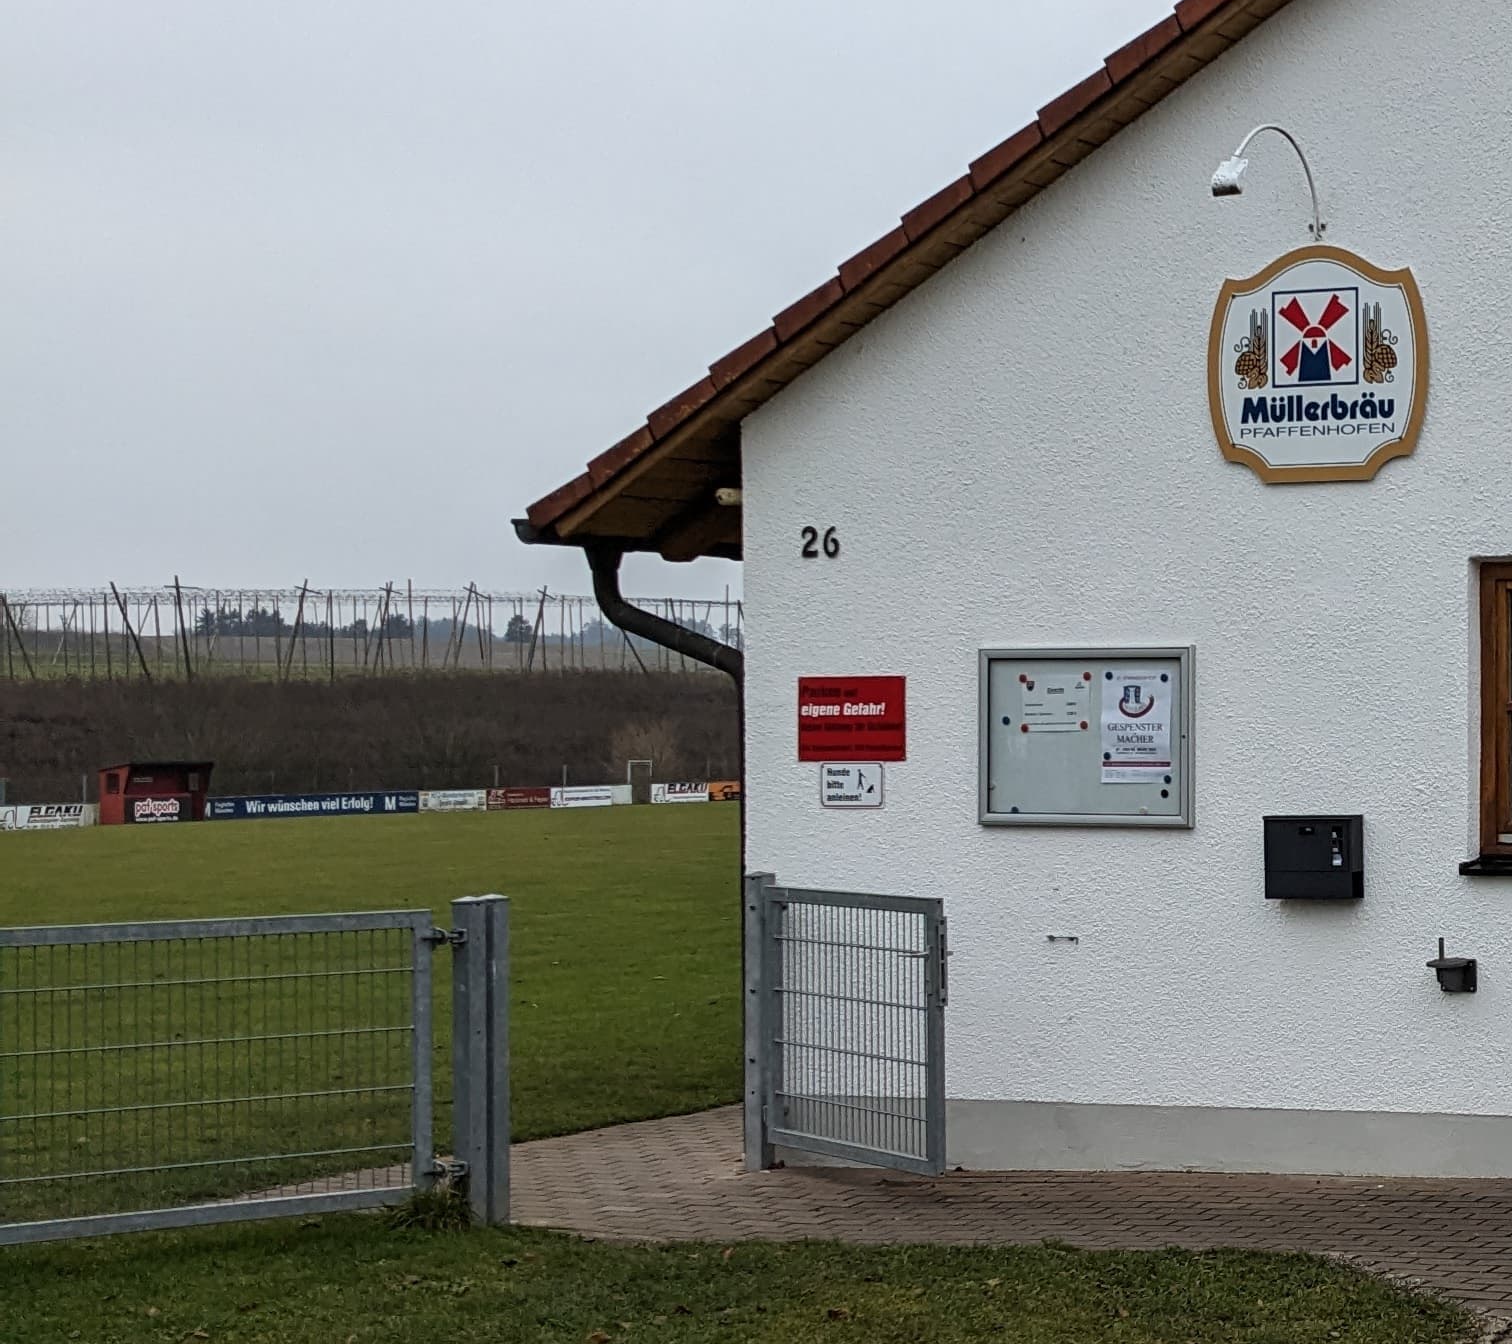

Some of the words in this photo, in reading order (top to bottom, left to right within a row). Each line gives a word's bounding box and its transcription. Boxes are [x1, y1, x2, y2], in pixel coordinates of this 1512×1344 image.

[1240, 392, 1395, 425] Müllerbräu
[1240, 422, 1396, 439] PFAFFENHOFEN
[801, 525, 840, 559] 26
[800, 704, 841, 717] eigene
[843, 702, 886, 716] Gefahr!
[1107, 722, 1163, 733] GESPENSTER
[1116, 735, 1155, 745] MACHER
[245, 800, 266, 814] Wir
[267, 799, 320, 813] wünschen
[321, 797, 341, 811] viel
[342, 796, 374, 812] Erfolg!
[385, 795, 397, 811] M
